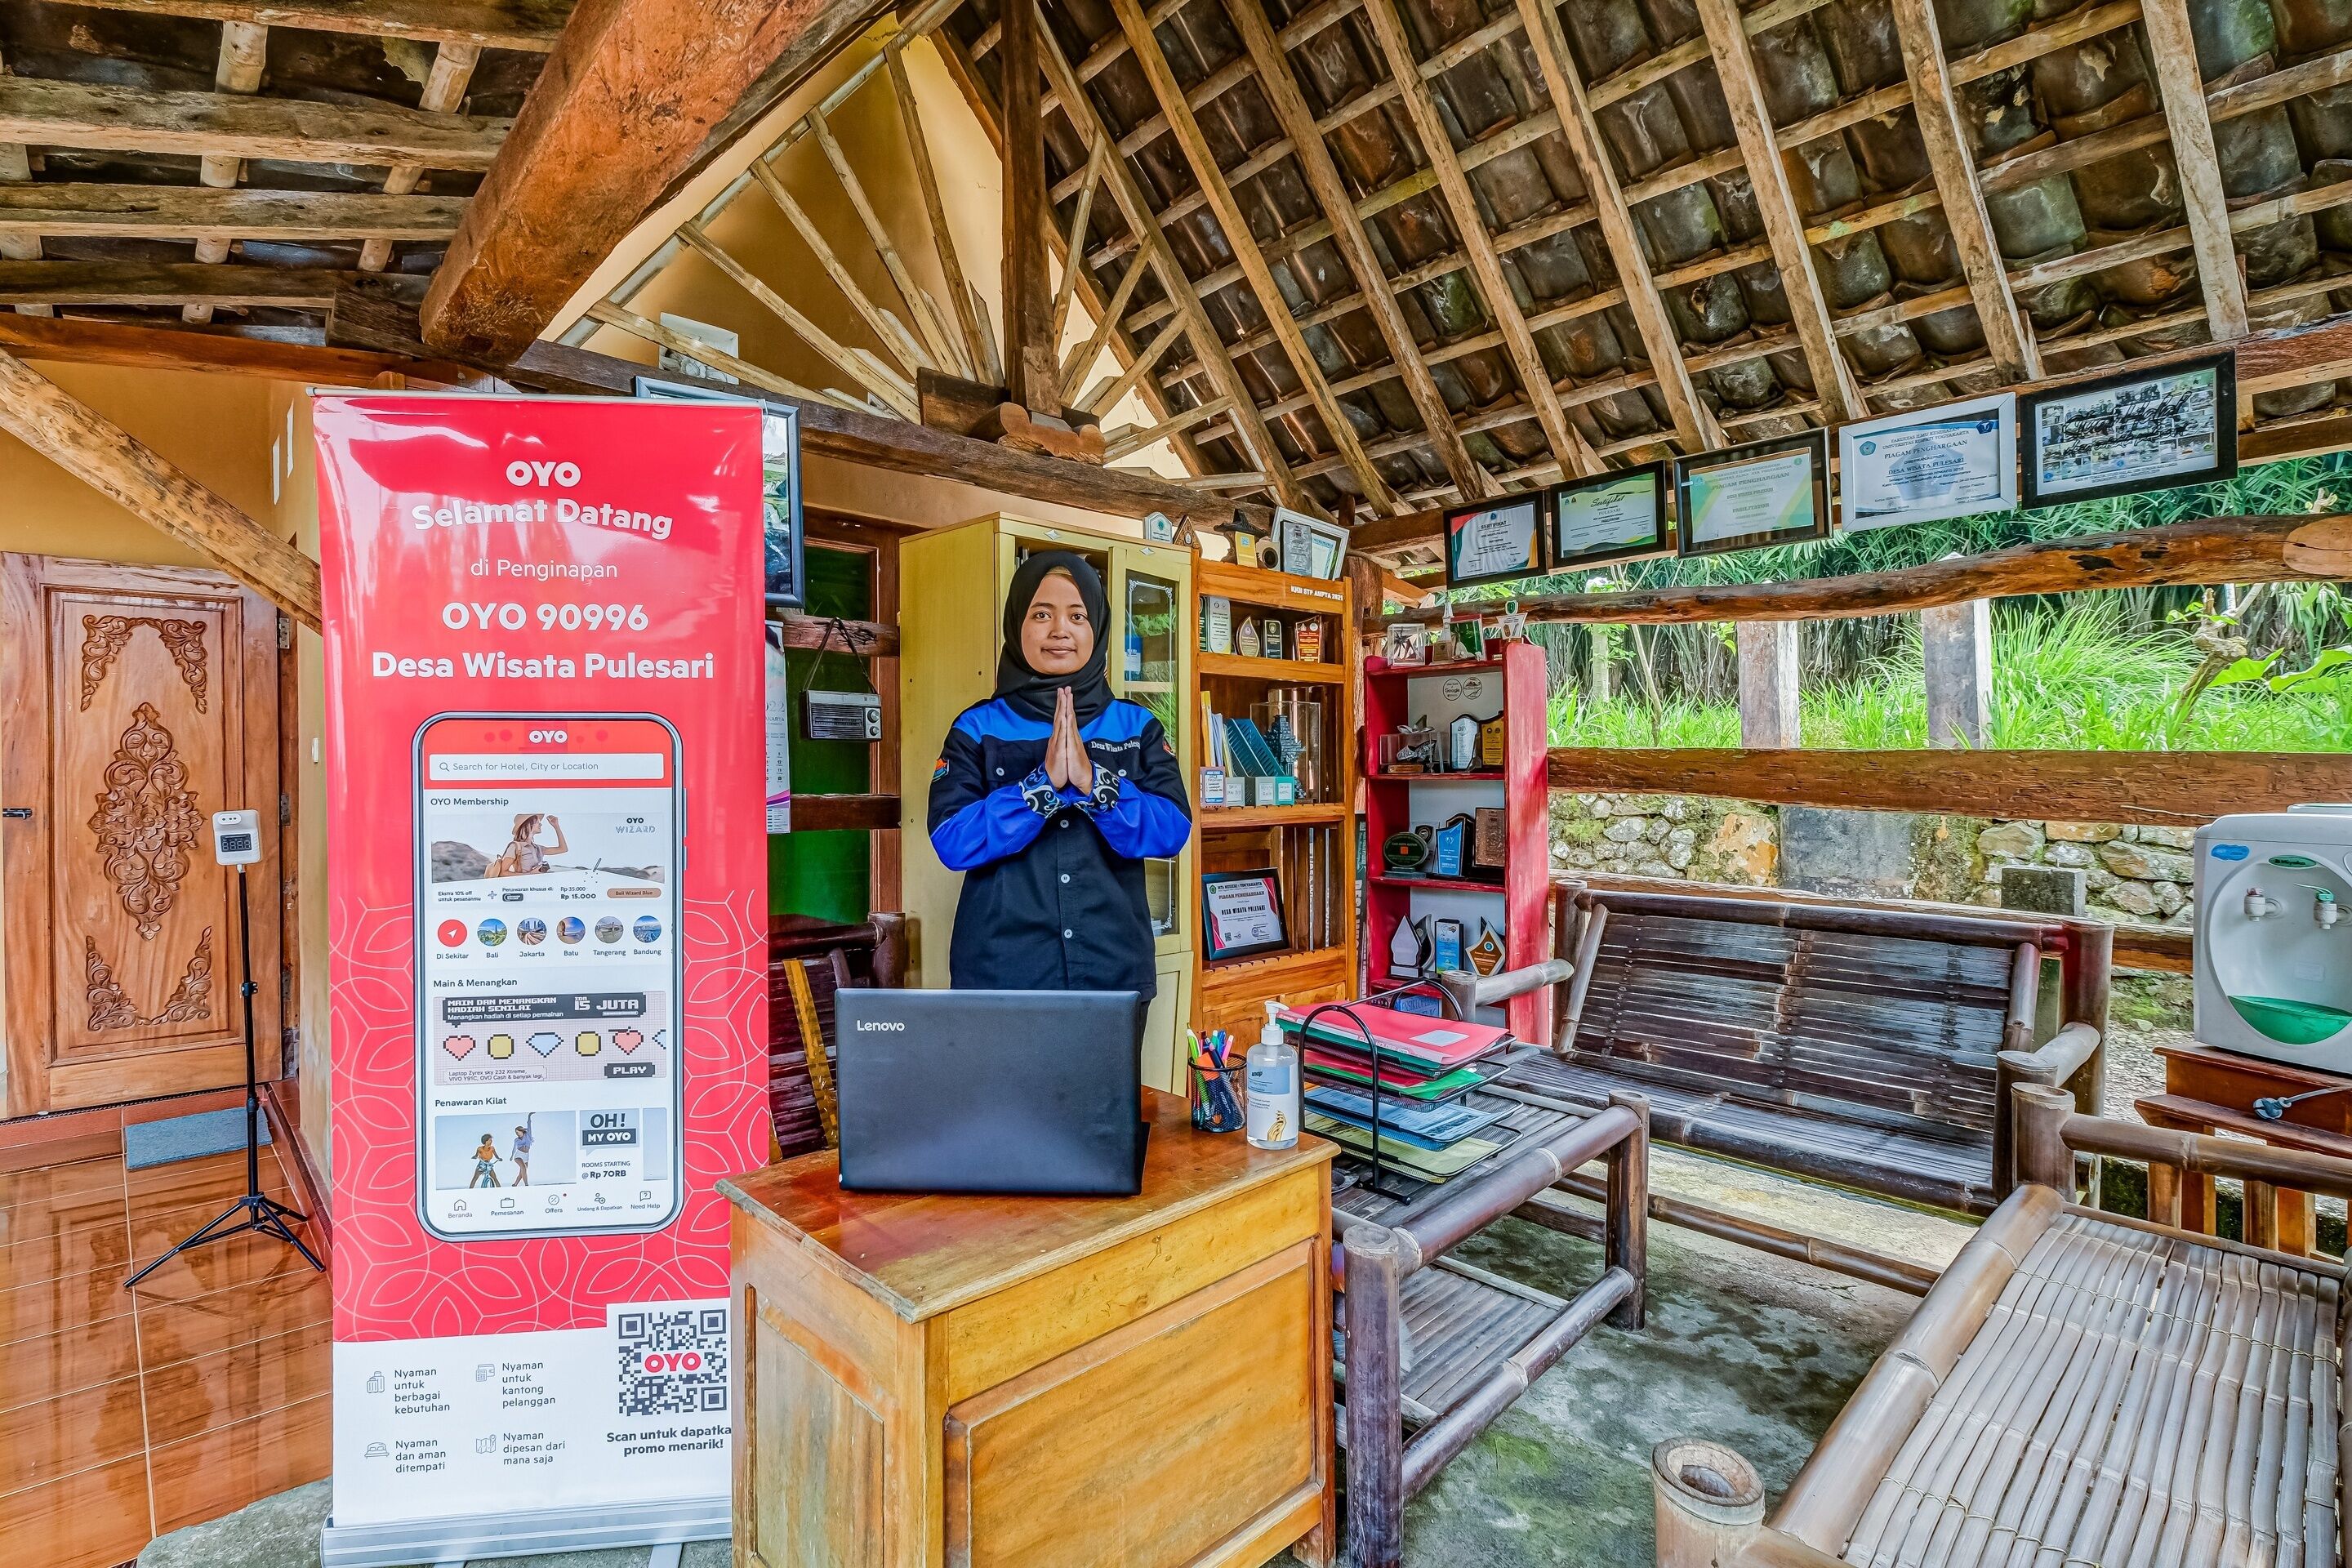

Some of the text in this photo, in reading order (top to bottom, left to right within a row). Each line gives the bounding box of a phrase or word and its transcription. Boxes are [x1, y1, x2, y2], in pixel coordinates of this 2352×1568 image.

[1884, 449, 1912, 460] PIAGAM
[1913, 439, 1968, 454] PENGHARGAAN
[506, 461, 581, 488] OYO
[412, 498, 673, 540] Selamat Datang
[470, 559, 618, 581] di Penginapan
[442, 603, 649, 631] OYO 90996
[372, 651, 714, 679] Desa Wisata Pulesari
[528, 730, 568, 744] OYO
[452, 762, 483, 771] Search
[485, 762, 498, 771] for
[501, 762, 528, 772] Hotel,
[531, 762, 549, 773] City
[563, 762, 599, 771] Location
[430, 797, 509, 807] OYO Membership
[519, 950, 546, 958] Jakarta
[593, 949, 626, 957] Tangerang
[633, 947, 662, 956] Bandung
[434, 978, 518, 988] Main & Menangkan
[499, 997, 557, 1005] MENANGKAN
[574, 999, 639, 1010] 15 JUTA
[513, 1012, 531, 1020] setiap
[532, 1011, 564, 1020] permainan
[857, 1020, 905, 1031] Lenovo
[612, 1066, 647, 1075] PLAY
[435, 1098, 483, 1107] Penawaran
[590, 1113, 626, 1129] OH!
[587, 1132, 631, 1143] MY OYO
[590, 1171, 601, 1179] Rp
[502, 1361, 544, 1374] Nyaman
[644, 1352, 702, 1373] OYO
[394, 1367, 437, 1379] Nyaman
[502, 1373, 532, 1383] untuk
[394, 1379, 425, 1390] untuk
[502, 1384, 544, 1397] kantong
[394, 1392, 441, 1405] berbagai
[502, 1396, 556, 1409] pelanggan
[394, 1402, 450, 1414] kebutuhan
[502, 1431, 544, 1444] Nyaman
[607, 1431, 637, 1443] Scan
[640, 1428, 677, 1441] untuk
[395, 1438, 438, 1450] Nyaman
[503, 1441, 566, 1456] dipesan dari
[623, 1439, 724, 1457] promo menarik!
[395, 1450, 446, 1461] dan aman
[503, 1454, 554, 1466] mana saja
[395, 1462, 446, 1475] ditempati
